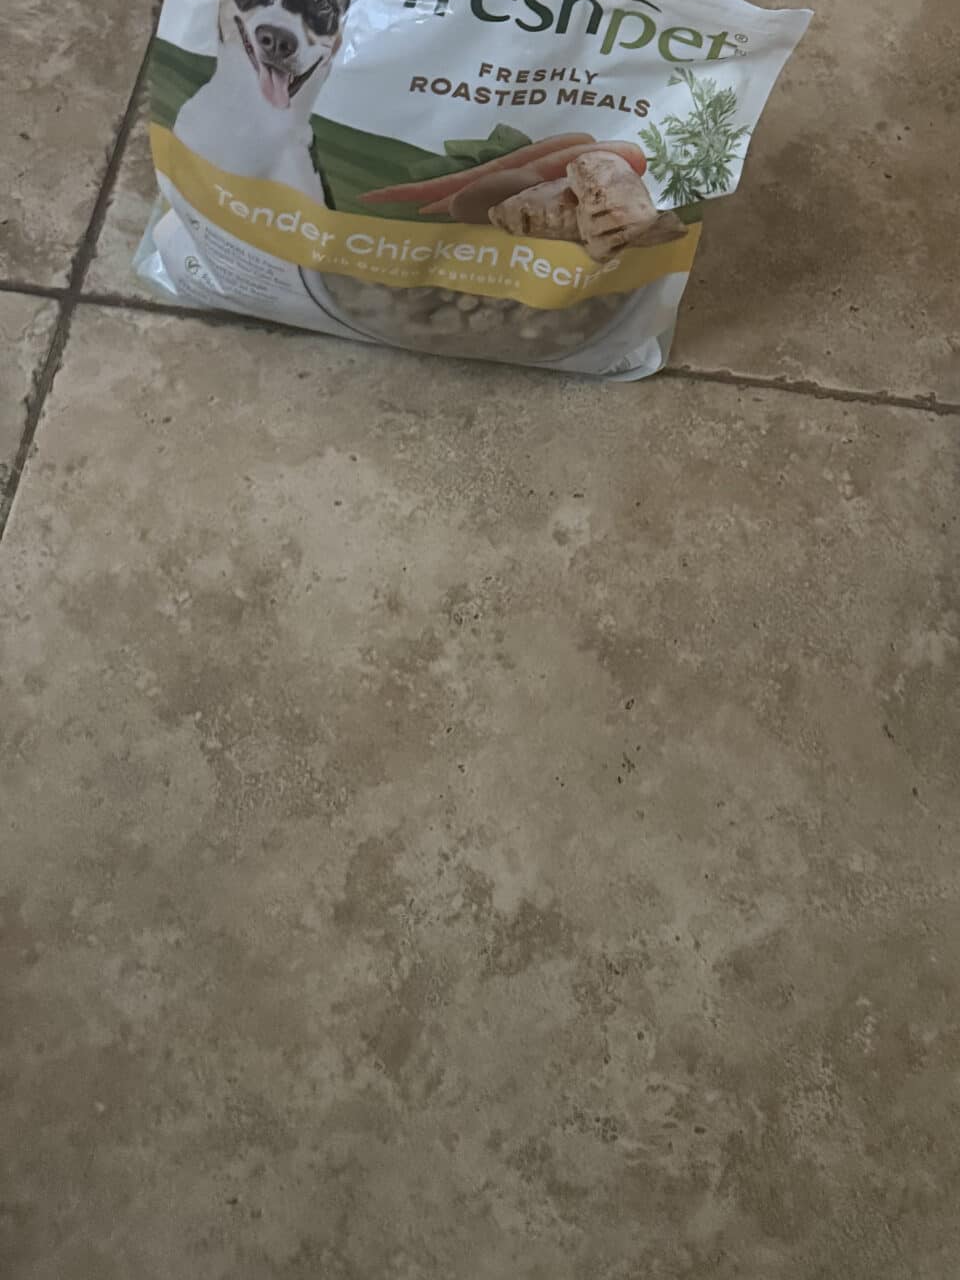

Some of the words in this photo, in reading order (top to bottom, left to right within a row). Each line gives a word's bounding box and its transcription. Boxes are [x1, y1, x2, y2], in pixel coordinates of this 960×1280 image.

[478, 61, 599, 86] FRESHLY
[409, 75, 548, 107] ROASTED
[556, 87, 651, 118] MEALS
[214, 183, 336, 247] Tender
[345, 232, 499, 268] Chicken
